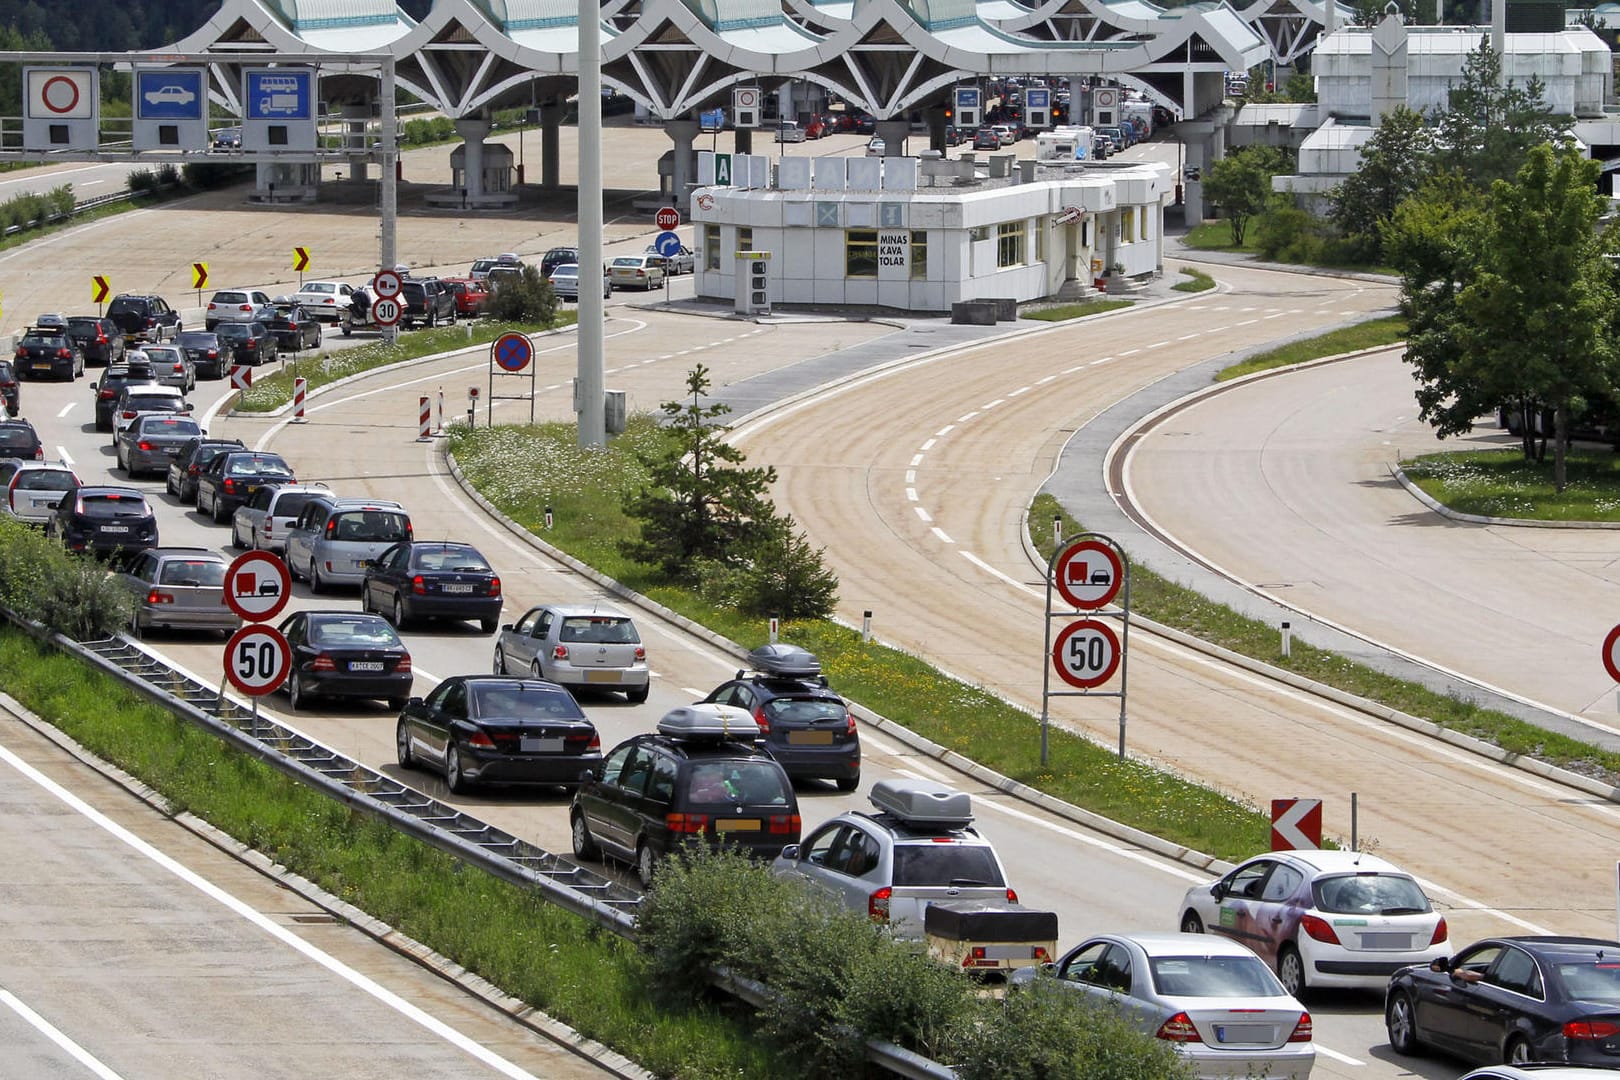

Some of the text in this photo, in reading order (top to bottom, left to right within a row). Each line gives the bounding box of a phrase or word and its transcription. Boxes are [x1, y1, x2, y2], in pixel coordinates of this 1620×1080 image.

[658, 214, 677, 225] STOP
[880, 235, 908, 245] MINAS
[879, 246, 903, 256] KAVA
[879, 257, 905, 266] TOLAR
[379, 303, 394, 319] 30
[1070, 636, 1104, 671] 50
[239, 641, 275, 679] 50
